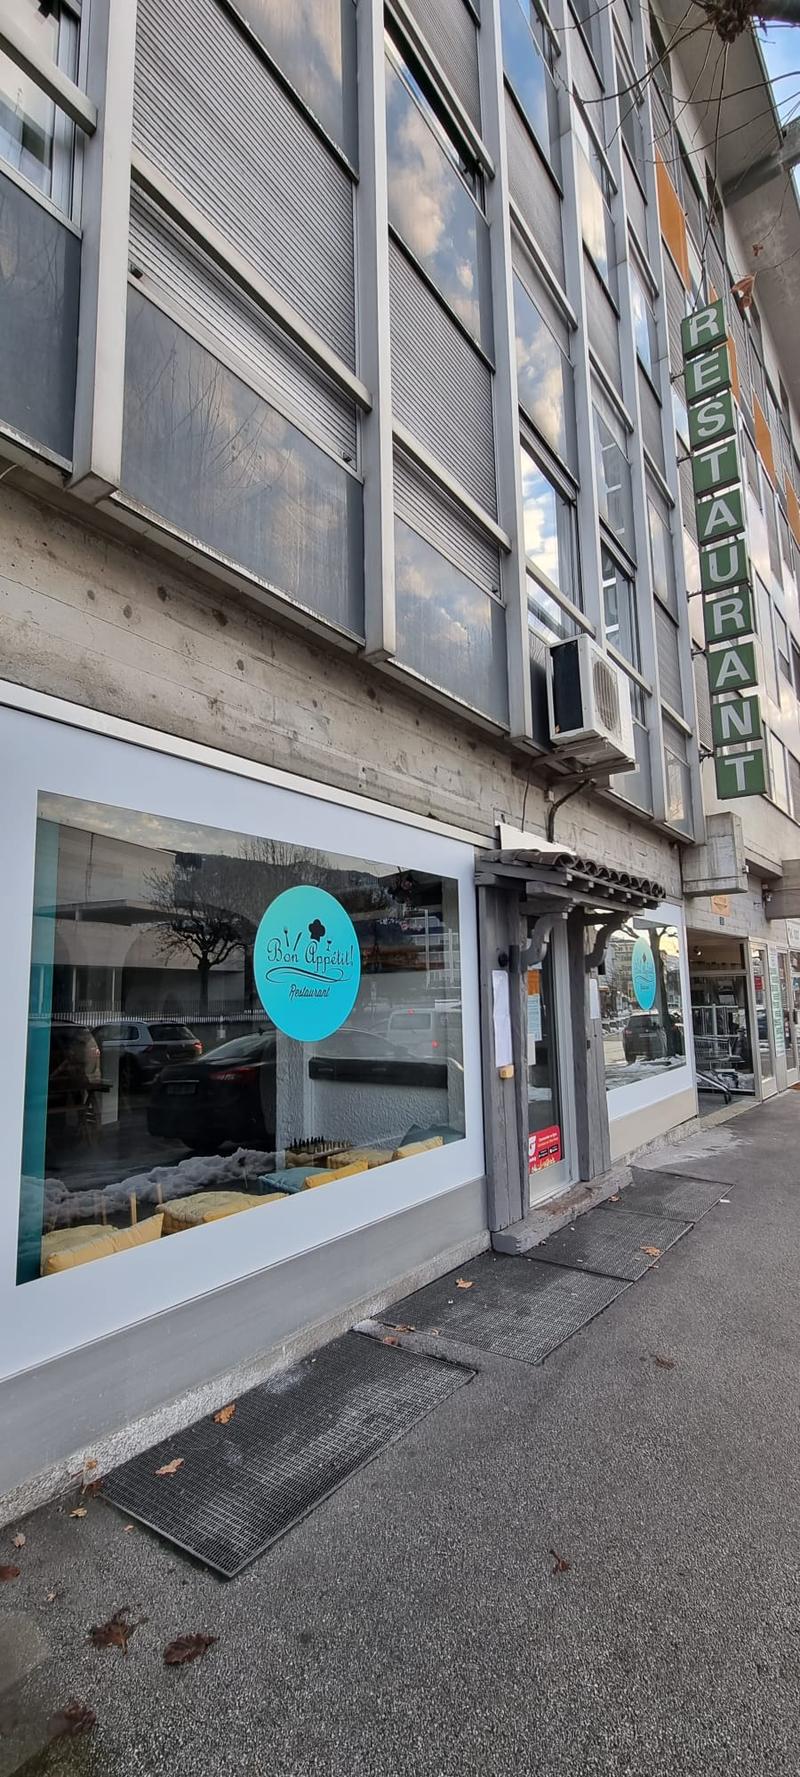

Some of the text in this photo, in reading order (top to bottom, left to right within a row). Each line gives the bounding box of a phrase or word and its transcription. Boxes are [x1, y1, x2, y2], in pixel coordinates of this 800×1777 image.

[689, 307, 754, 792] RESTAURANT
[267, 938, 354, 973] Bon Appétit!
[289, 984, 331, 1000] Restaurant
